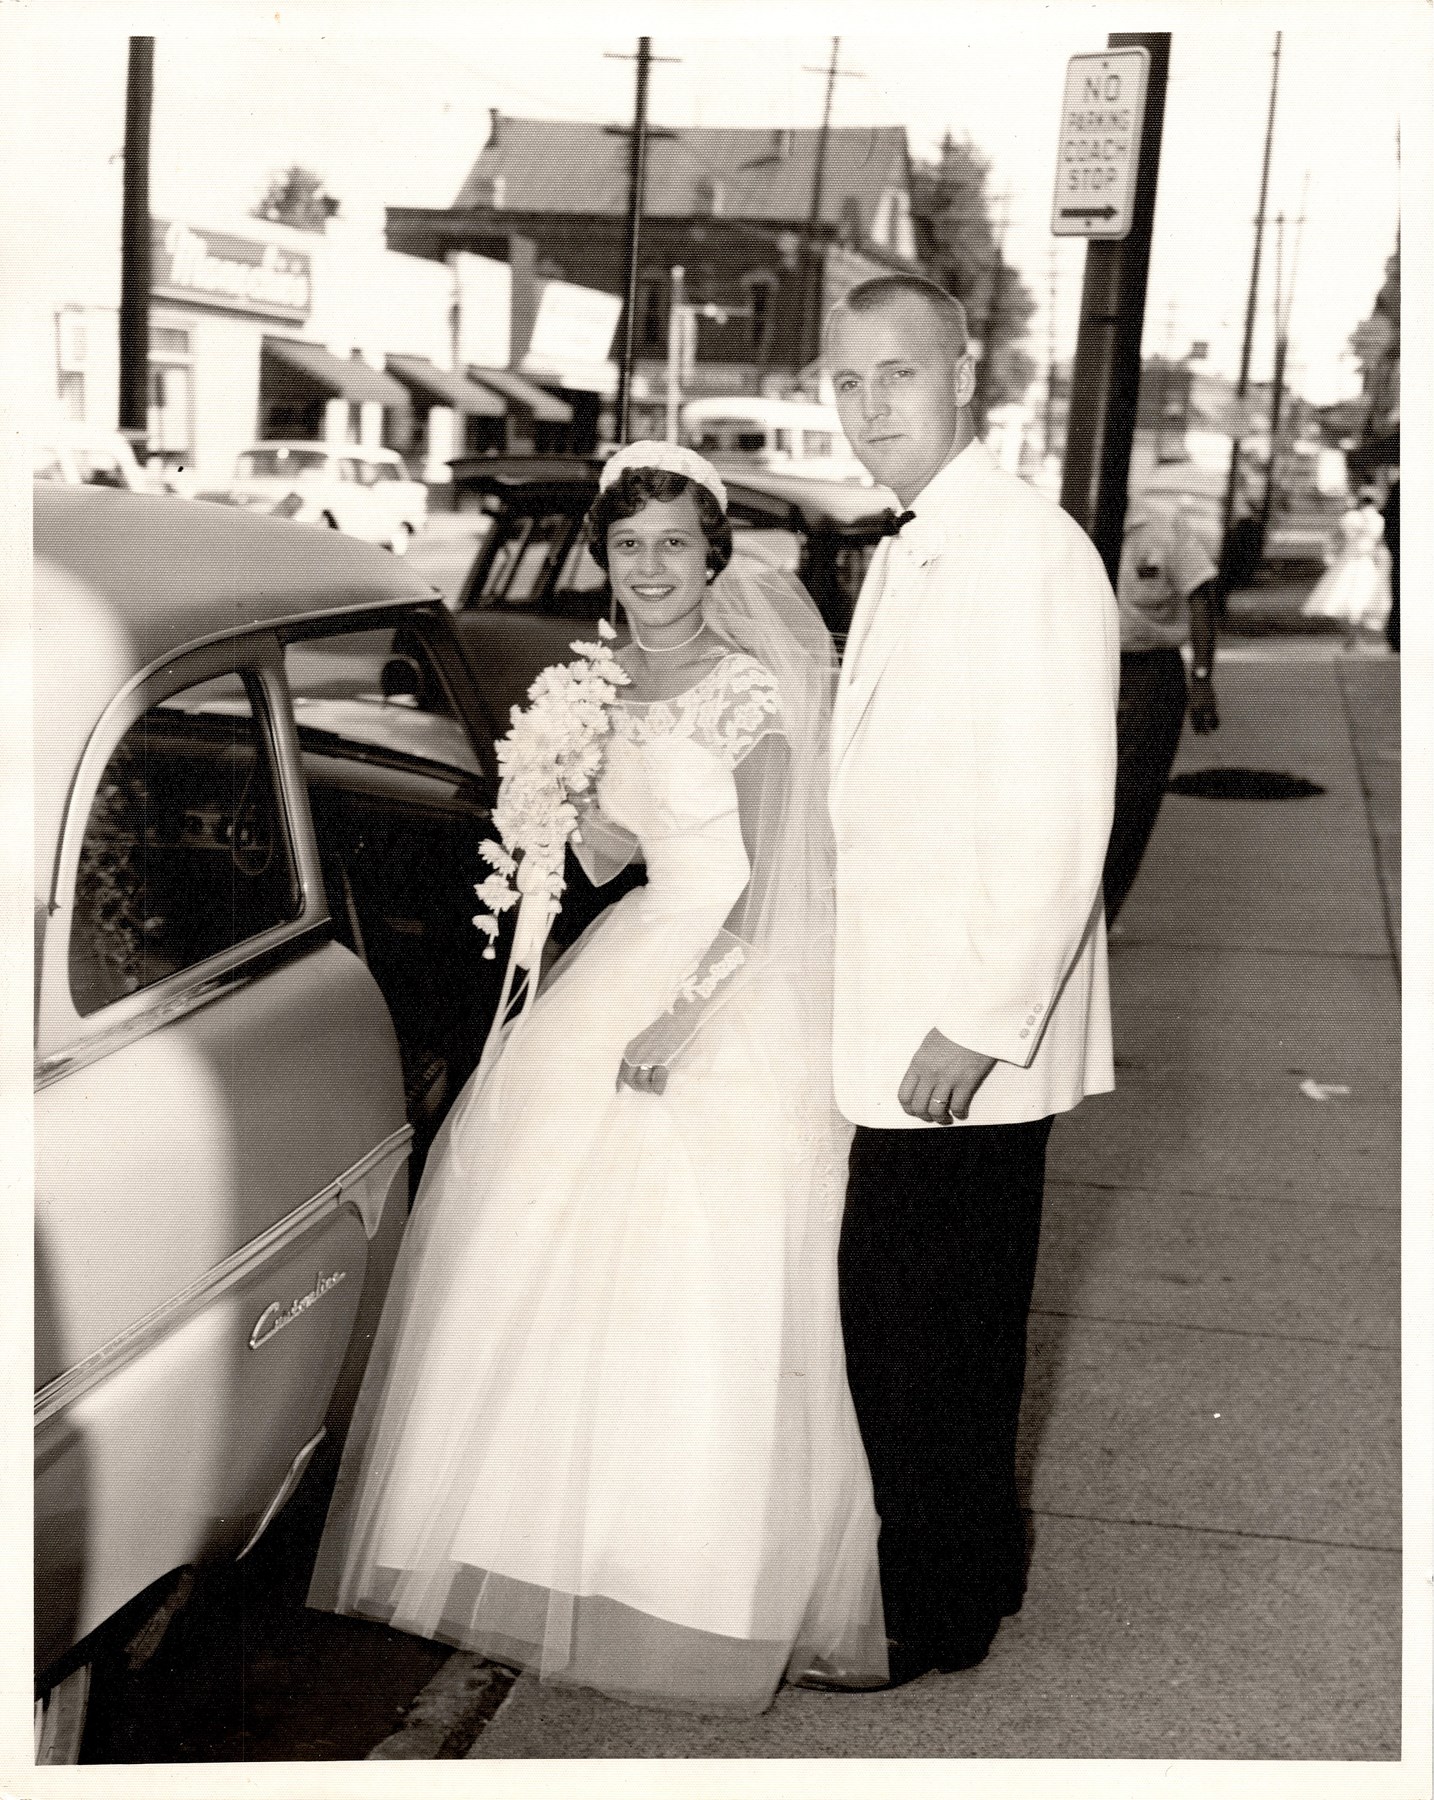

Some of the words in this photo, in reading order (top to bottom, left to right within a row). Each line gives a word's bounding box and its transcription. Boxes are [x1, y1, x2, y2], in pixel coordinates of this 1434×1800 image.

[1083, 74, 1121, 102] NO
[1069, 109, 1130, 131] PARKING
[1065, 138, 1127, 163] COACH
[1067, 167, 1117, 191] STOP
[248, 1270, 346, 1349] Customline
